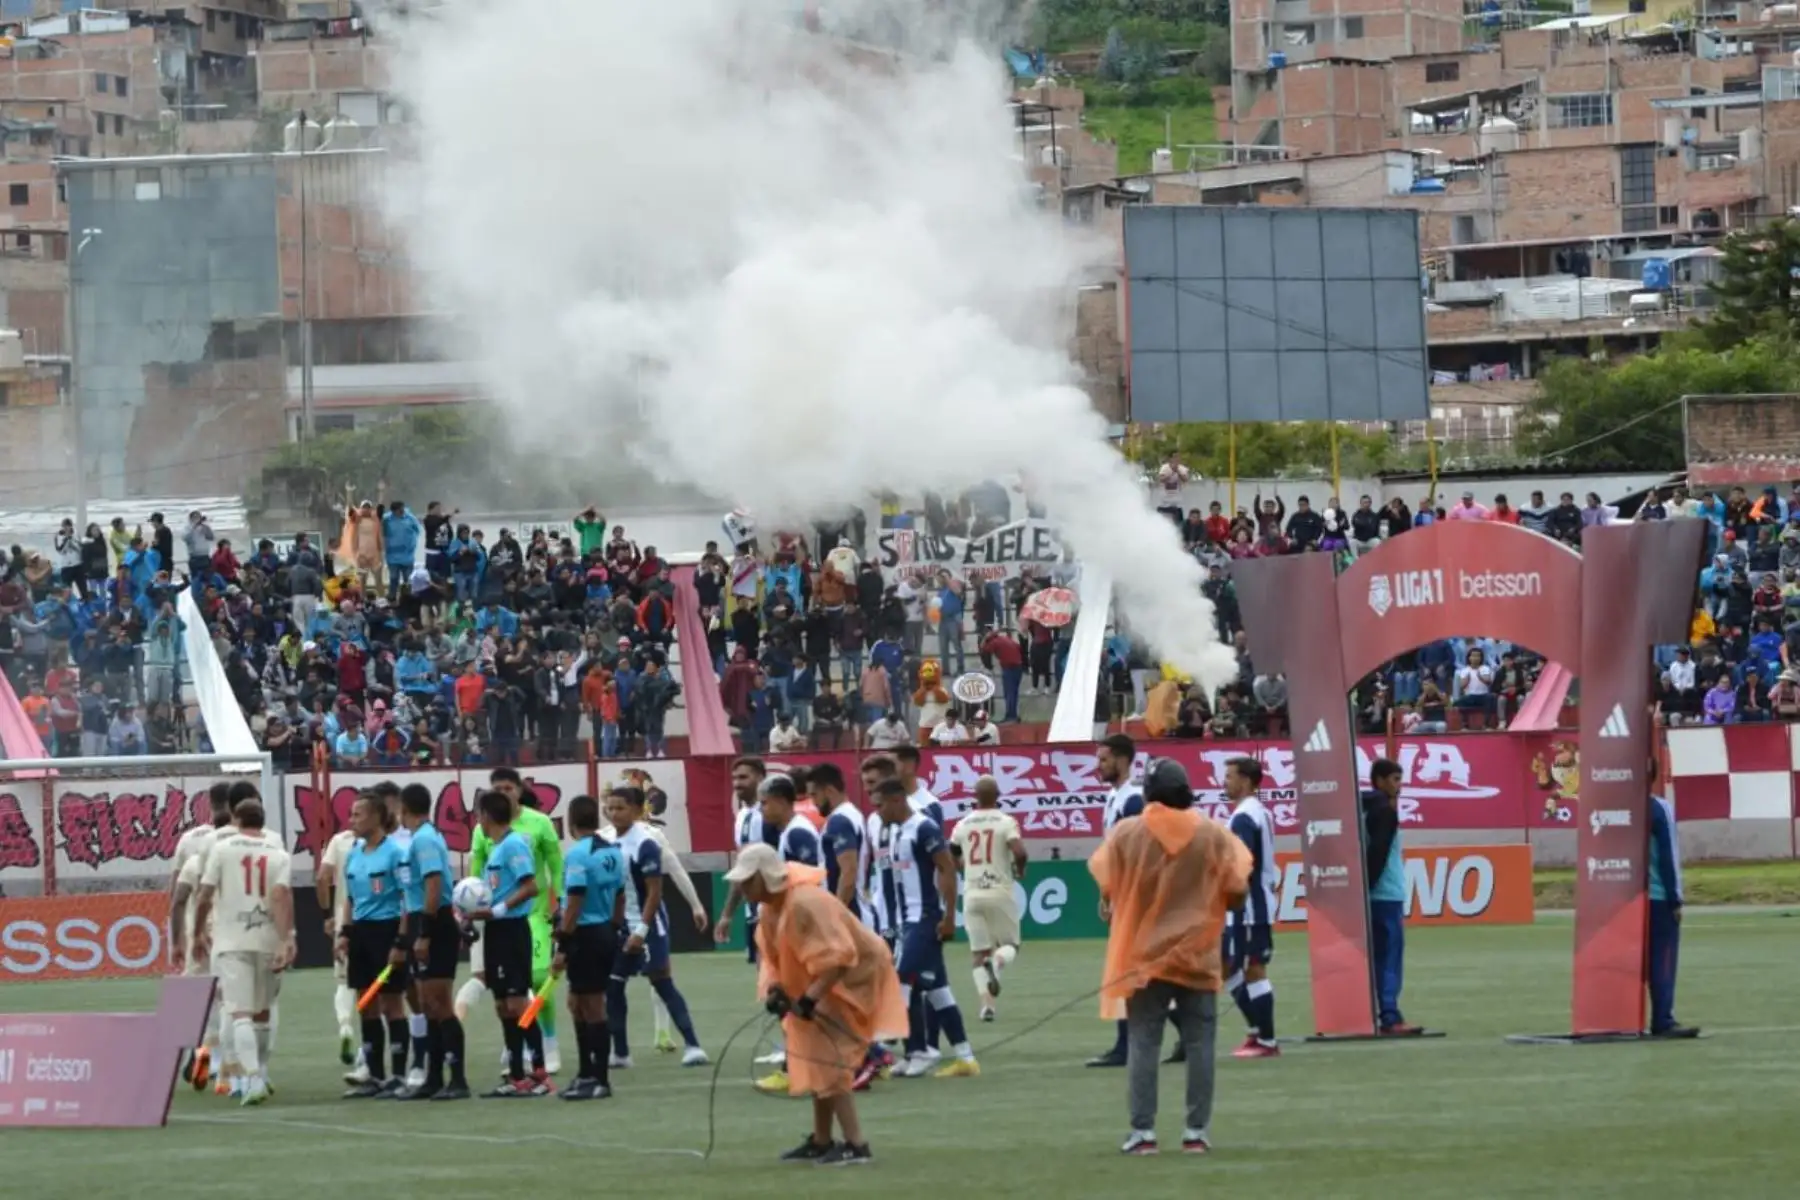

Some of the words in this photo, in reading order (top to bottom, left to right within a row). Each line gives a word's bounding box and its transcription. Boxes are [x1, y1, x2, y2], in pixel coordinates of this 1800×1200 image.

[1460, 569, 1542, 599] betsson
[967, 828, 995, 865] 27
[240, 854, 268, 898] 11
[1, 915, 172, 974] SSO
[26, 1052, 92, 1082] betsson
